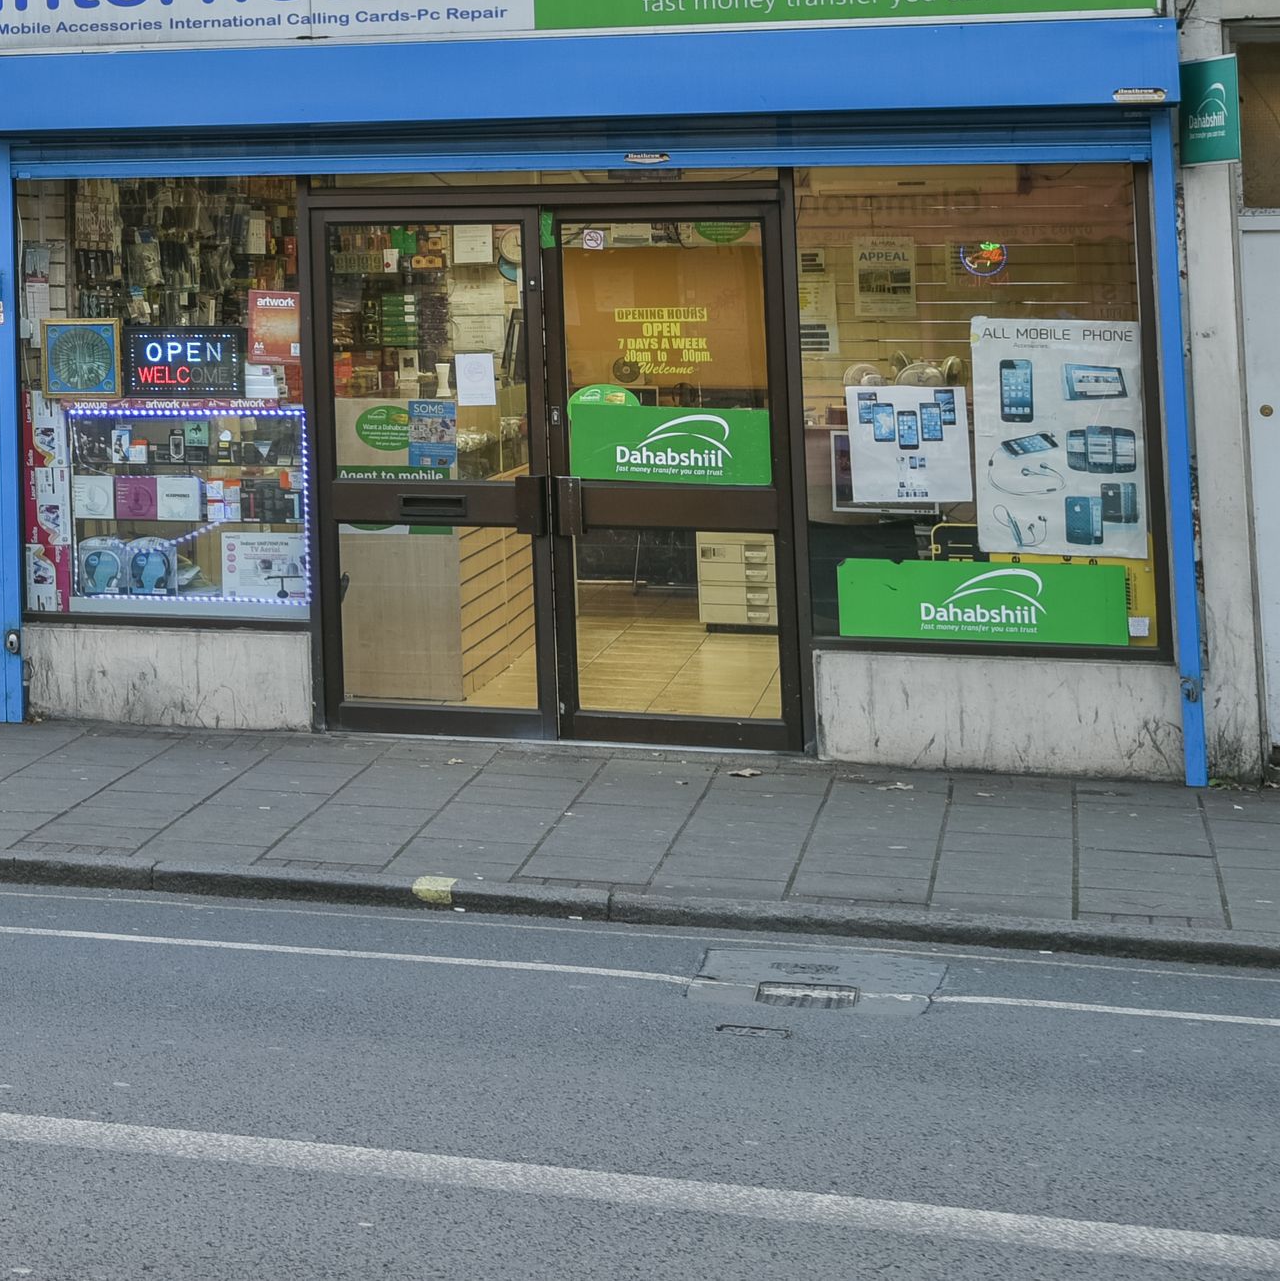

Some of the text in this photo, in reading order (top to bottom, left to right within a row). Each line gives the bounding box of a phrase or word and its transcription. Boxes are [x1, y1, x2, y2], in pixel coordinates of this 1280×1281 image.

[55, 17, 163, 34] Accessories
[169, 12, 282, 30] International
[286, 10, 350, 28] Calling
[446, 5, 508, 23] Repair
[1188, 111, 1225, 129] Dahabshiil
[858, 250, 910, 262] APPEAL
[256, 296, 295, 307] artwork
[617, 308, 705, 320] OPENING HOURS
[642, 322, 680, 336] OPEN
[982, 327, 1134, 342] ALL MOBILE PHONE
[617, 338, 708, 349] 7 DAYS A WEEK
[145, 342, 222, 362] OPEN
[657, 350, 667, 361] to
[638, 361, 695, 374] Welcome
[138, 366, 230, 384] WELCOME
[145, 399, 180, 409] artwork
[230, 399, 265, 408] artwork
[413, 404, 444, 414] SOMS
[616, 445, 723, 467] Dahabshiil
[615, 464, 629, 473] fast
[629, 466, 651, 474] money
[652, 465, 679, 475] transfer
[680, 468, 692, 476] you
[707, 468, 723, 476] trust
[920, 602, 1038, 624] Dahabshiil
[920, 622, 1038, 634] fast money transfer you can trust
